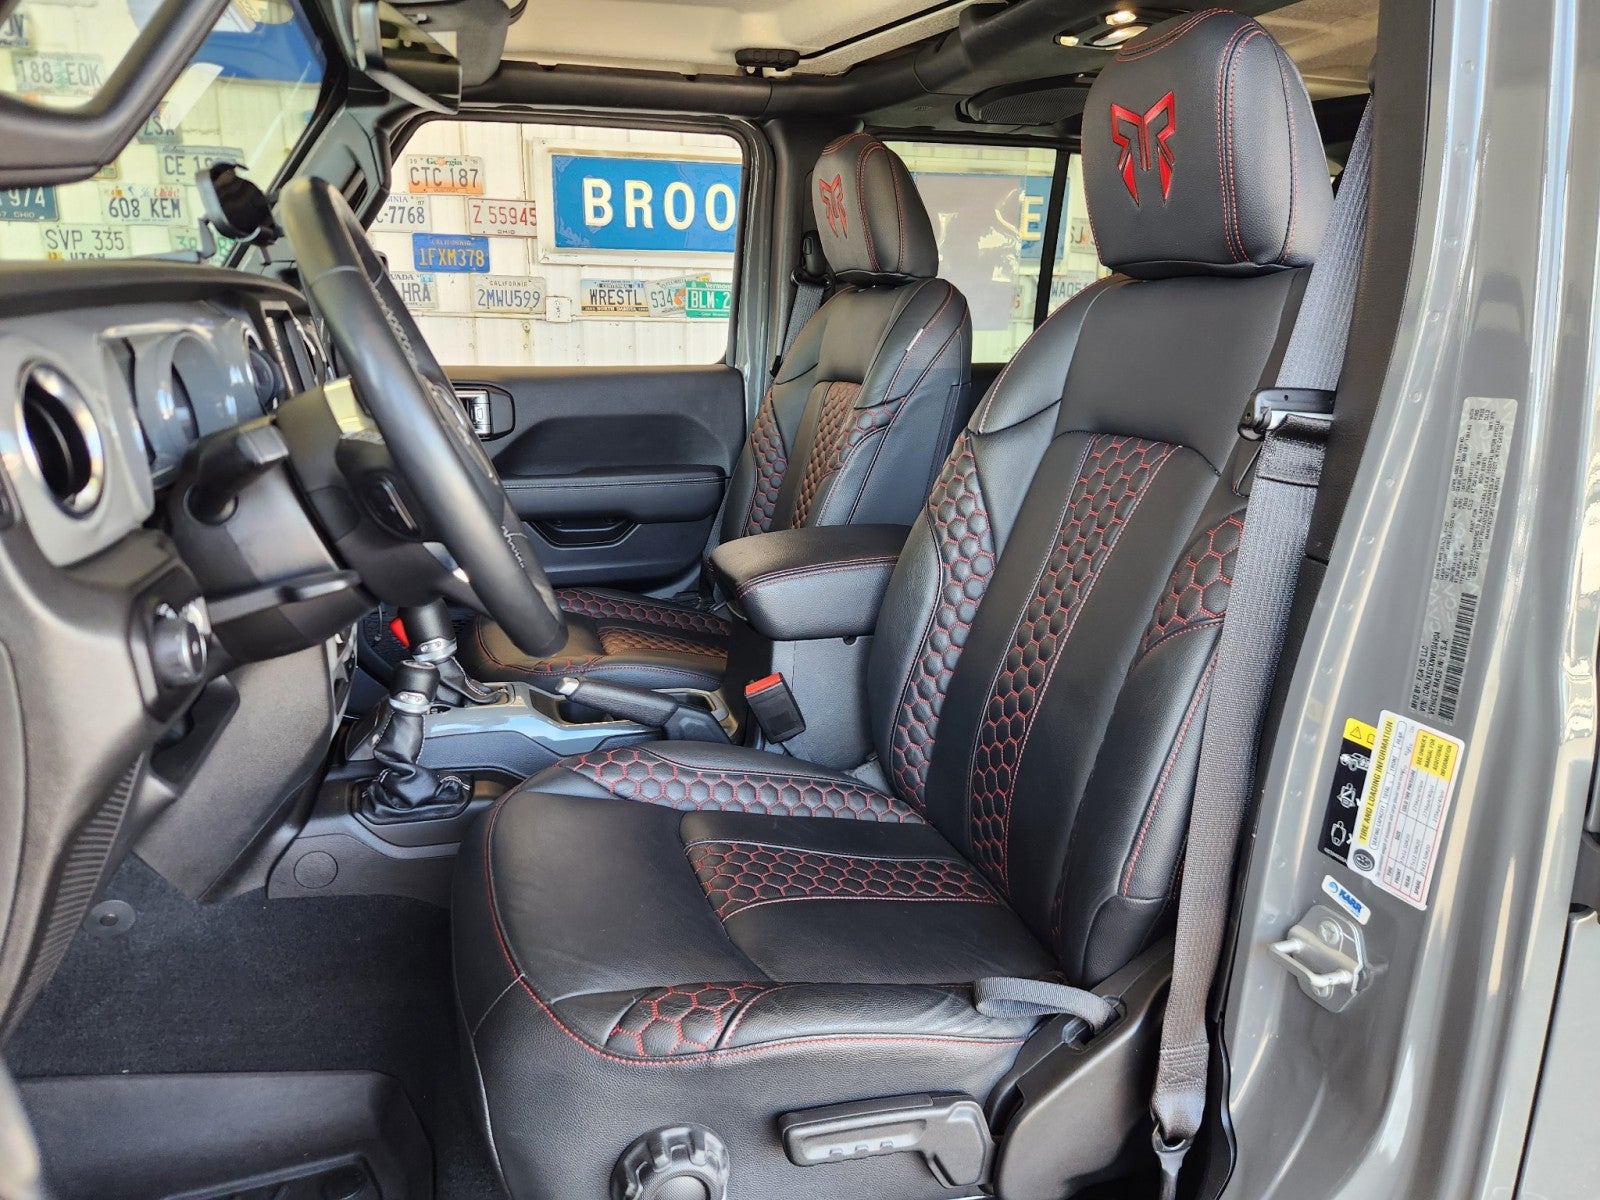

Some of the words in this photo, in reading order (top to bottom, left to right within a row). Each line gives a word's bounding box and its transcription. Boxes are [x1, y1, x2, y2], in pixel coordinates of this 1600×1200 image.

[18, 60, 53, 84] 188
[164, 155, 186, 175] CE
[410, 166, 442, 186] CTC
[450, 167, 478, 188] 187
[109, 197, 140, 218] 608
[583, 177, 736, 232] BROO
[472, 205, 482, 224] Z
[488, 206, 537, 227] 55945
[1021, 196, 1043, 240] E
[45, 228, 83, 250] SVP
[91, 230, 125, 251] 335
[419, 248, 485, 267] 1FXM378
[401, 283, 431, 302] HRA
[477, 289, 541, 309] 2MWU599
[589, 289, 642, 305] WRESTL
[651, 288, 673, 308] S34
[692, 290, 715, 309] BLM
[1419, 657, 1426, 668] US
[1416, 667, 1424, 681] FCA
[1428, 688, 1438, 716] VEHICLE
[1433, 668, 1442, 688] MADE
[1376, 719, 1393, 773] INFORMATION
[1368, 772, 1380, 806] LOADING
[1364, 806, 1372, 823] AND
[1360, 822, 1369, 841] TIRE
[1339, 889, 1361, 913] KARR
